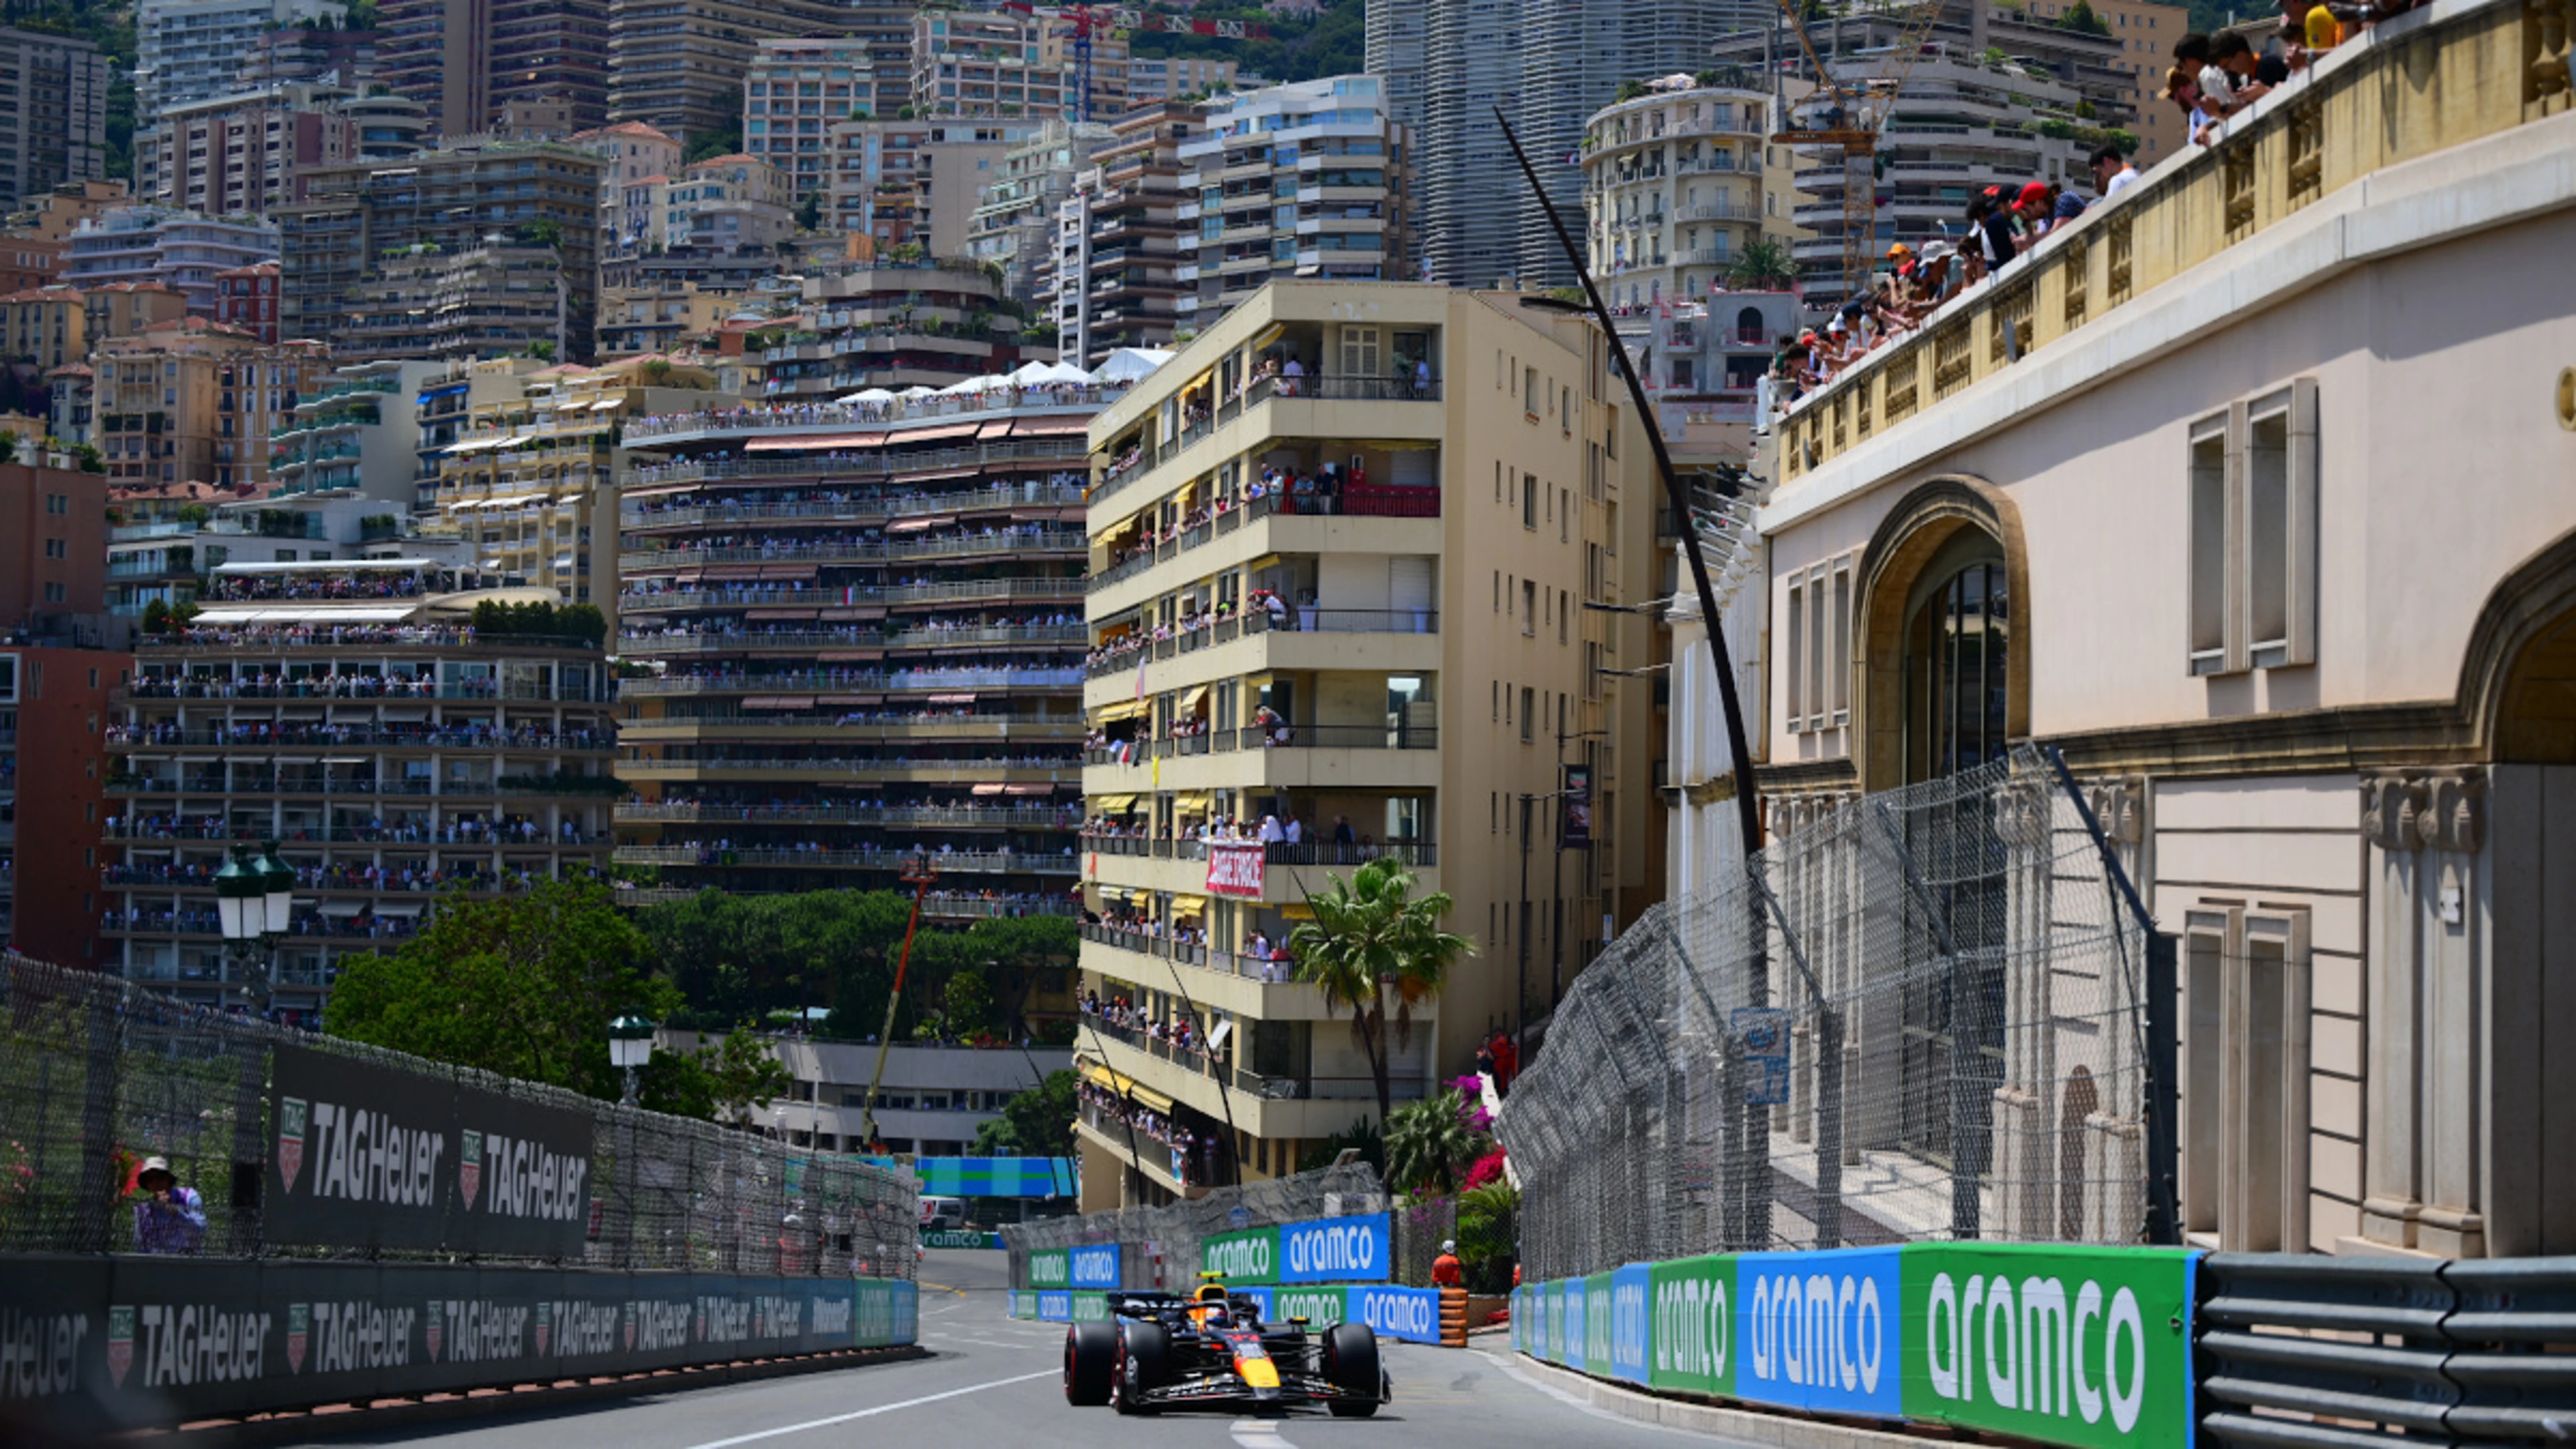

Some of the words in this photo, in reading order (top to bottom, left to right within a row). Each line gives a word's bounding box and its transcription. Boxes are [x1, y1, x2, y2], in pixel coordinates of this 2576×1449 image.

[1209, 1237, 1269, 1277] aramco
[1290, 1225, 1373, 1273] aramco
[1280, 1293, 1340, 1328] aramco
[1364, 1292, 1430, 1334] aramco
[1656, 1278, 1727, 1379] aramco
[1752, 1274, 1881, 1395] aramco
[1927, 1272, 2145, 1434] aramco
